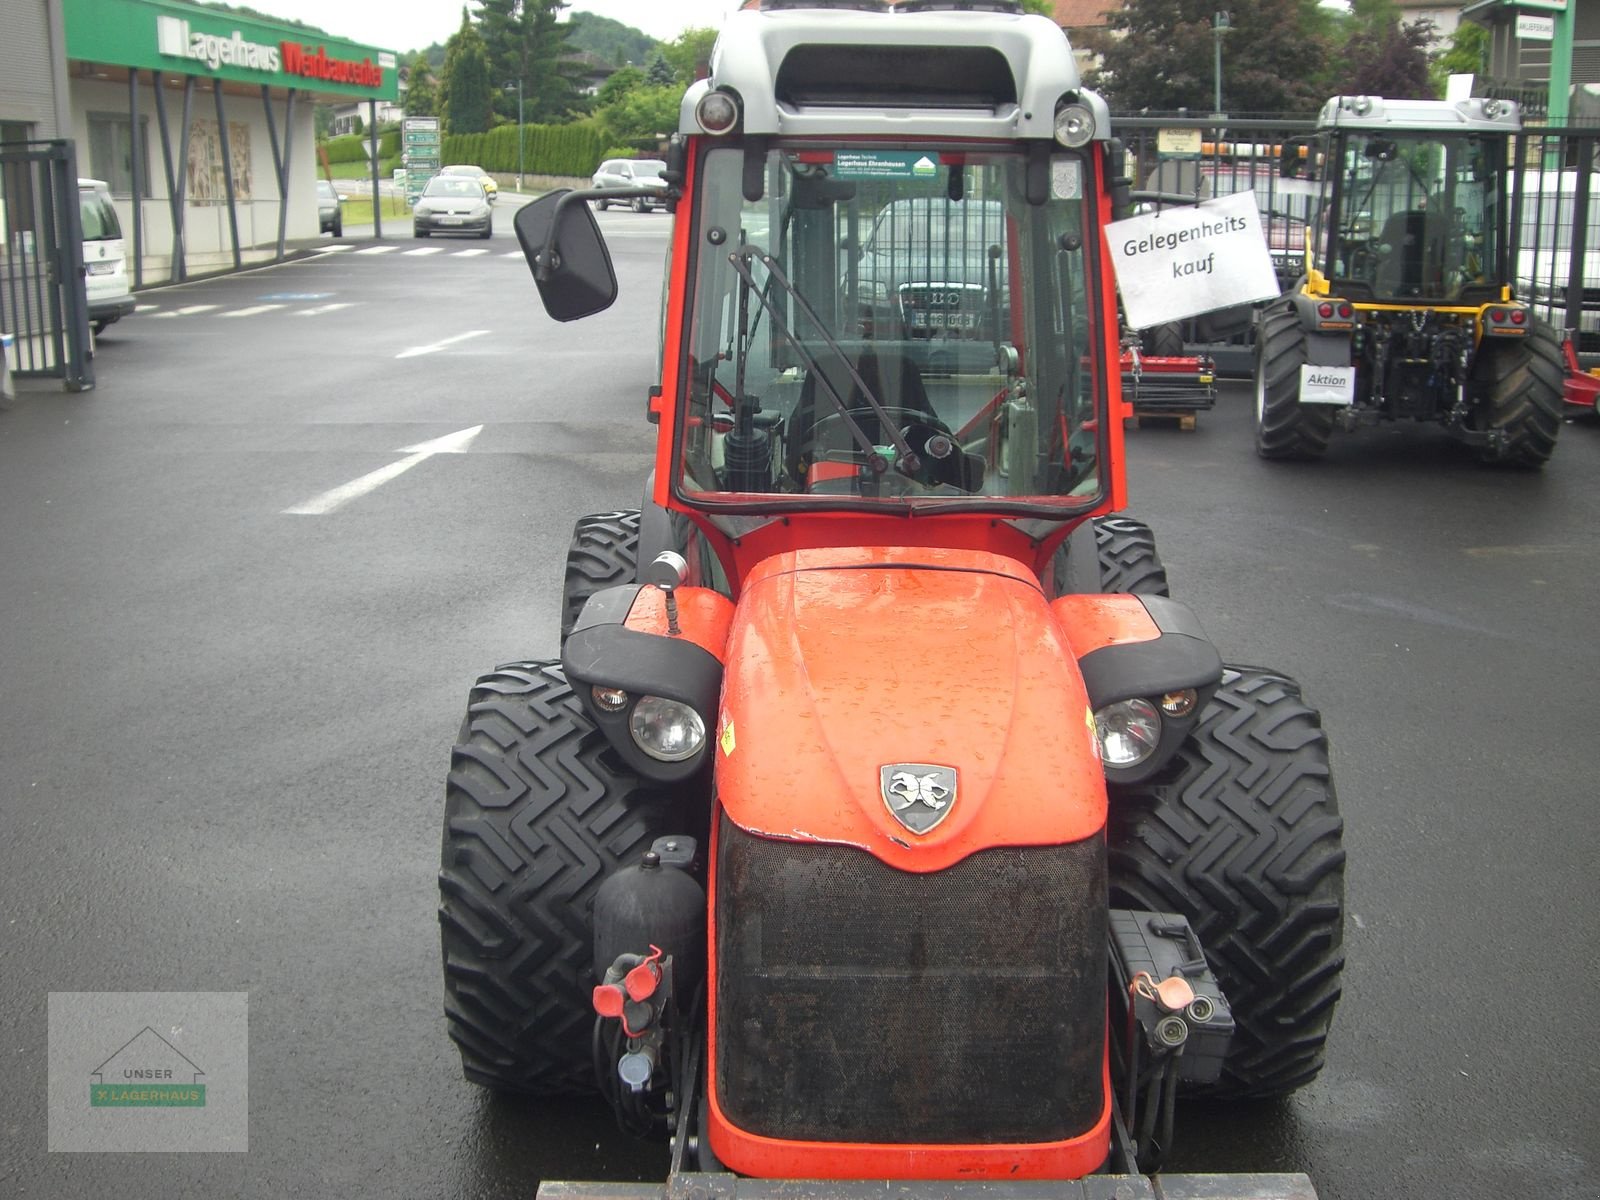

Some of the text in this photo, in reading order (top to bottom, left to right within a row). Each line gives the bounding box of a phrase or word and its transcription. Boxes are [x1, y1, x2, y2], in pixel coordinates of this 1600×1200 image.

[181, 19, 384, 88] Lagerhaus Weinbaucenter
[837, 160, 868, 168] Lagerhaus
[1123, 216, 1247, 257] Gelegenheits
[1172, 252, 1215, 279] kauf
[1307, 373, 1347, 386] Aktion
